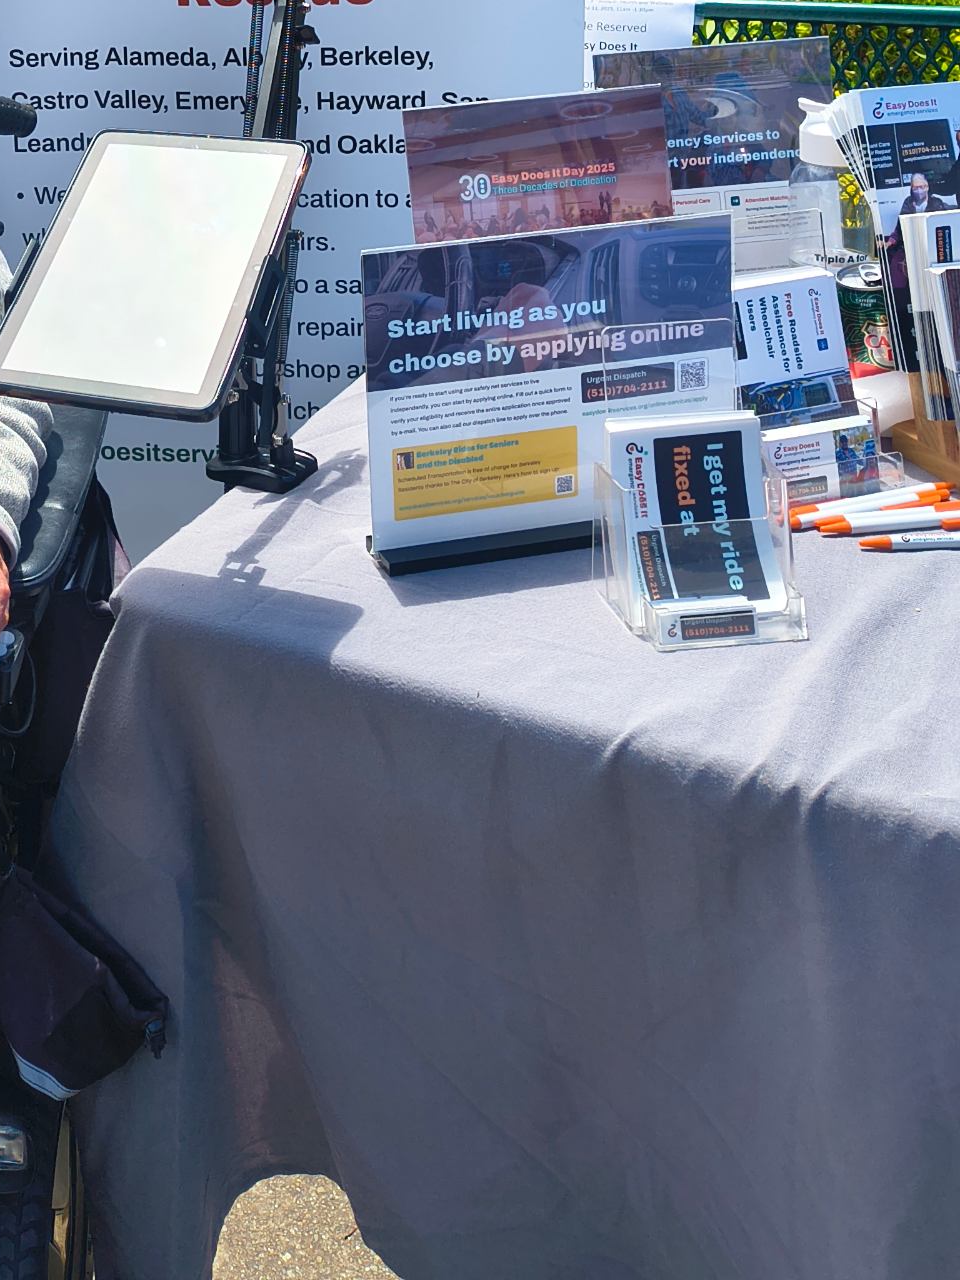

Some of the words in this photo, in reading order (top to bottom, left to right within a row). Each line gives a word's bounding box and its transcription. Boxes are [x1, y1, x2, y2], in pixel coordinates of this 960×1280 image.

[597, 22, 647, 33] Reserved
[584, 42, 595, 52] sy
[600, 41, 627, 51] Does
[630, 42, 638, 52] It
[9, 47, 100, 70] Serving
[104, 47, 217, 70] Alameda,
[320, 46, 434, 71] Berkeley,
[94, 90, 169, 113] Valley,
[885, 102, 907, 110] Easy
[908, 99, 930, 108] Does
[301, 135, 331, 154] nd
[337, 135, 406, 154] Oakla
[667, 136, 701, 149] ency
[703, 131, 764, 146] Services
[766, 130, 780, 140] to
[902, 145, 947, 157] (510)704-2111
[491, 172, 519, 185] Easy
[521, 168, 551, 181] Does
[552, 167, 561, 177] It
[563, 165, 585, 179] Day
[586, 162, 616, 174] 2025
[667, 157, 678, 168] rt
[681, 155, 713, 169] your
[458, 173, 491, 201] 30
[492, 185, 518, 196] Three
[519, 181, 558, 194] Decades
[559, 180, 569, 189] of
[570, 174, 617, 188] Dedication
[297, 189, 369, 208] cation
[376, 189, 399, 208] to
[814, 254, 845, 265] Triple
[856, 254, 868, 263] for
[315, 279, 329, 294] a
[335, 279, 362, 294] sa
[746, 299, 757, 332] Users
[784, 292, 793, 318] Free
[387, 315, 451, 339] Start
[456, 305, 525, 332] living
[528, 304, 558, 322] as
[562, 297, 607, 324] you
[758, 296, 775, 359] Wheelchair
[771, 295, 787, 357] Assistance
[782, 357, 790, 373] for
[788, 319, 803, 370] Roadside
[387, 349, 482, 374] choose
[486, 343, 516, 366] by
[520, 325, 627, 362] applying
[630, 320, 705, 346] online
[586, 374, 612, 384] Urgent
[613, 370, 647, 381] Dispatch
[412, 392, 428, 400] ready
[474, 384, 490, 392] safety
[430, 402, 441, 410] you
[473, 395, 496, 404] applying
[538, 387, 553, 395] quick
[586, 380, 667, 400] (510)704-2111
[416, 448, 453, 458] Berkeley
[488, 439, 519, 449] Seniors
[783, 444, 798, 452] Easy
[798, 442, 815, 450] Does
[416, 462, 433, 470] and
[672, 445, 696, 507] fixed
[703, 455, 728, 496] get
[634, 456, 643, 482] Easy
[640, 510, 649, 519] It
[680, 510, 701, 537] at
[712, 499, 732, 537] my
[639, 535, 661, 600] (510)704-211
[719, 541, 744, 591] ride
[685, 624, 750, 638] (510)704-2111
